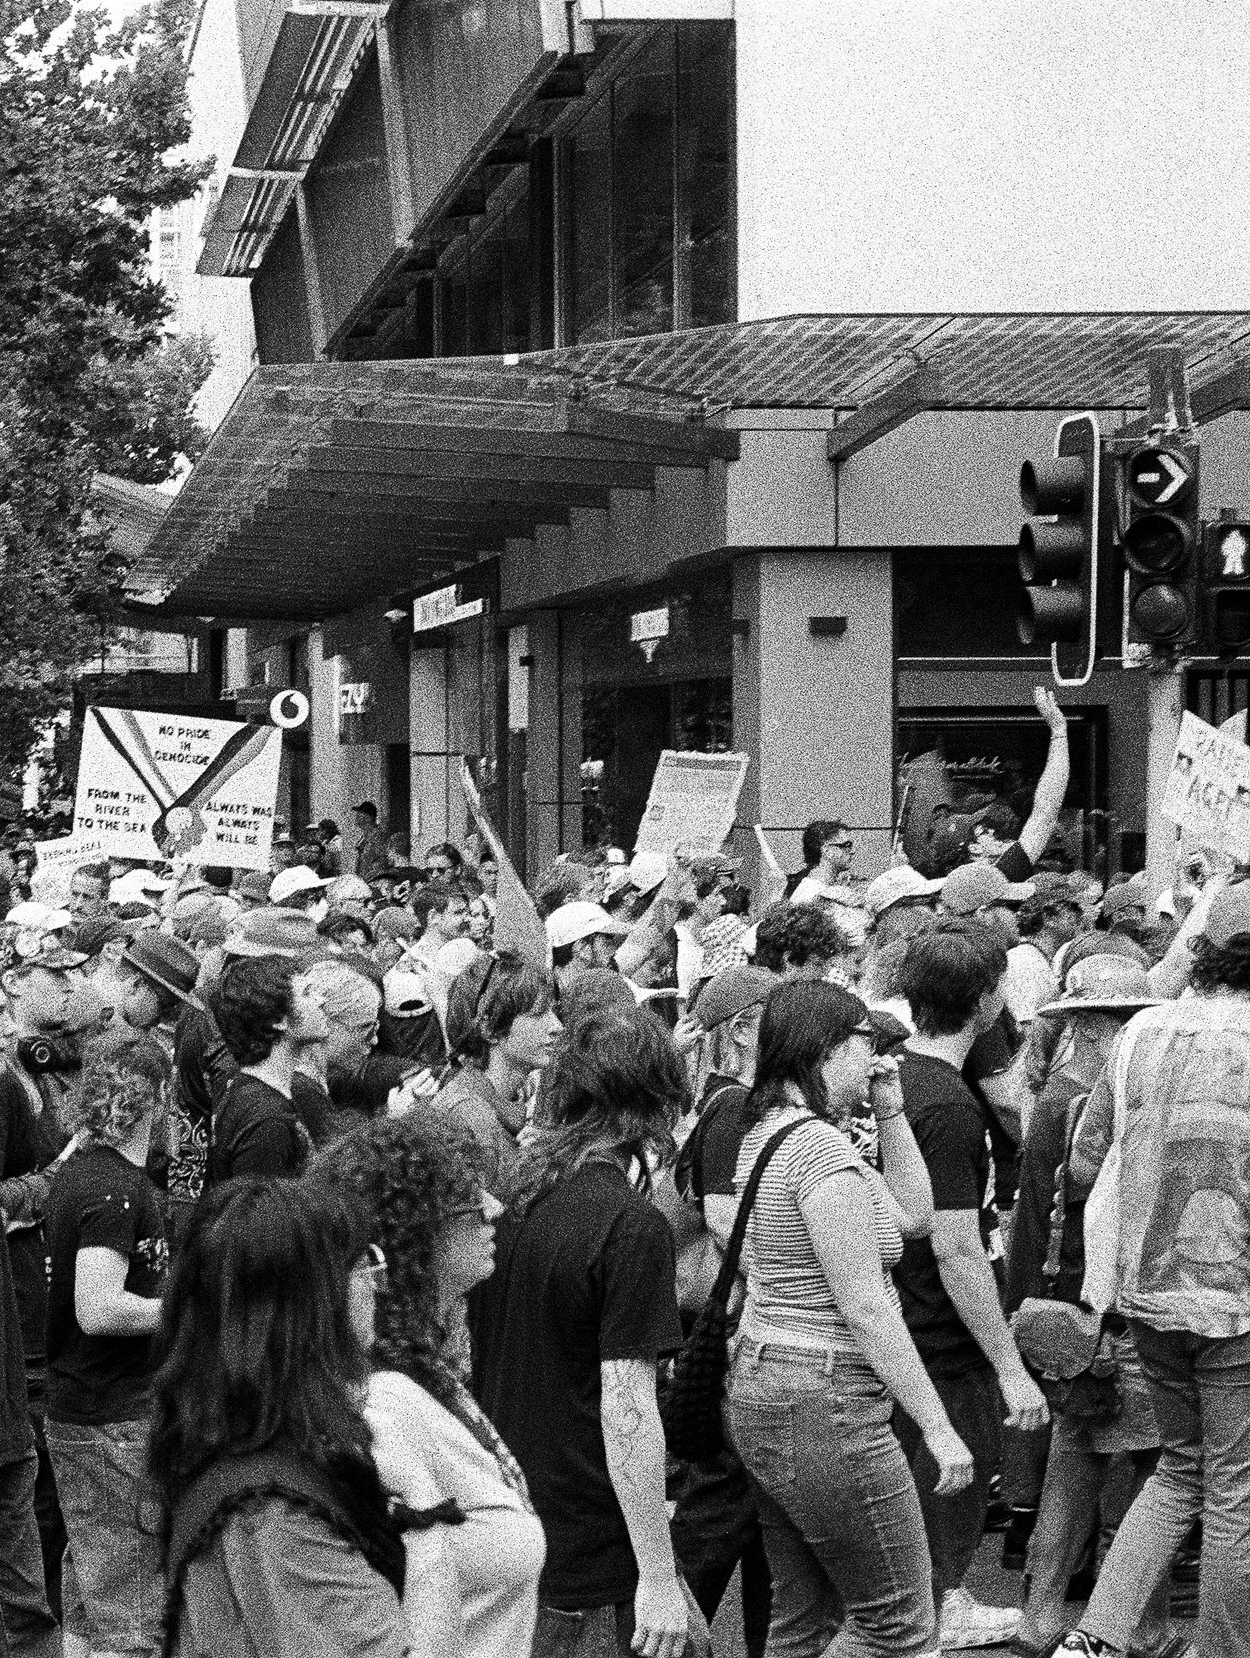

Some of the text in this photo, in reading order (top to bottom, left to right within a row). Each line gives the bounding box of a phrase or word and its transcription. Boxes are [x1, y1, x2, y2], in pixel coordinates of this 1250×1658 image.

[159, 726, 212, 740] NO PRIDE
[180, 741, 191, 751] IN
[154, 750, 210, 766] GENOCIDE
[87, 788, 146, 804] FROM THE
[95, 803, 130, 816] RIVER
[205, 802, 273, 818] ALWAYS WAS
[78, 816, 147, 833] TO THE SEA
[217, 817, 259, 831] ALWAYS
[215, 832, 258, 845] WILL BE
